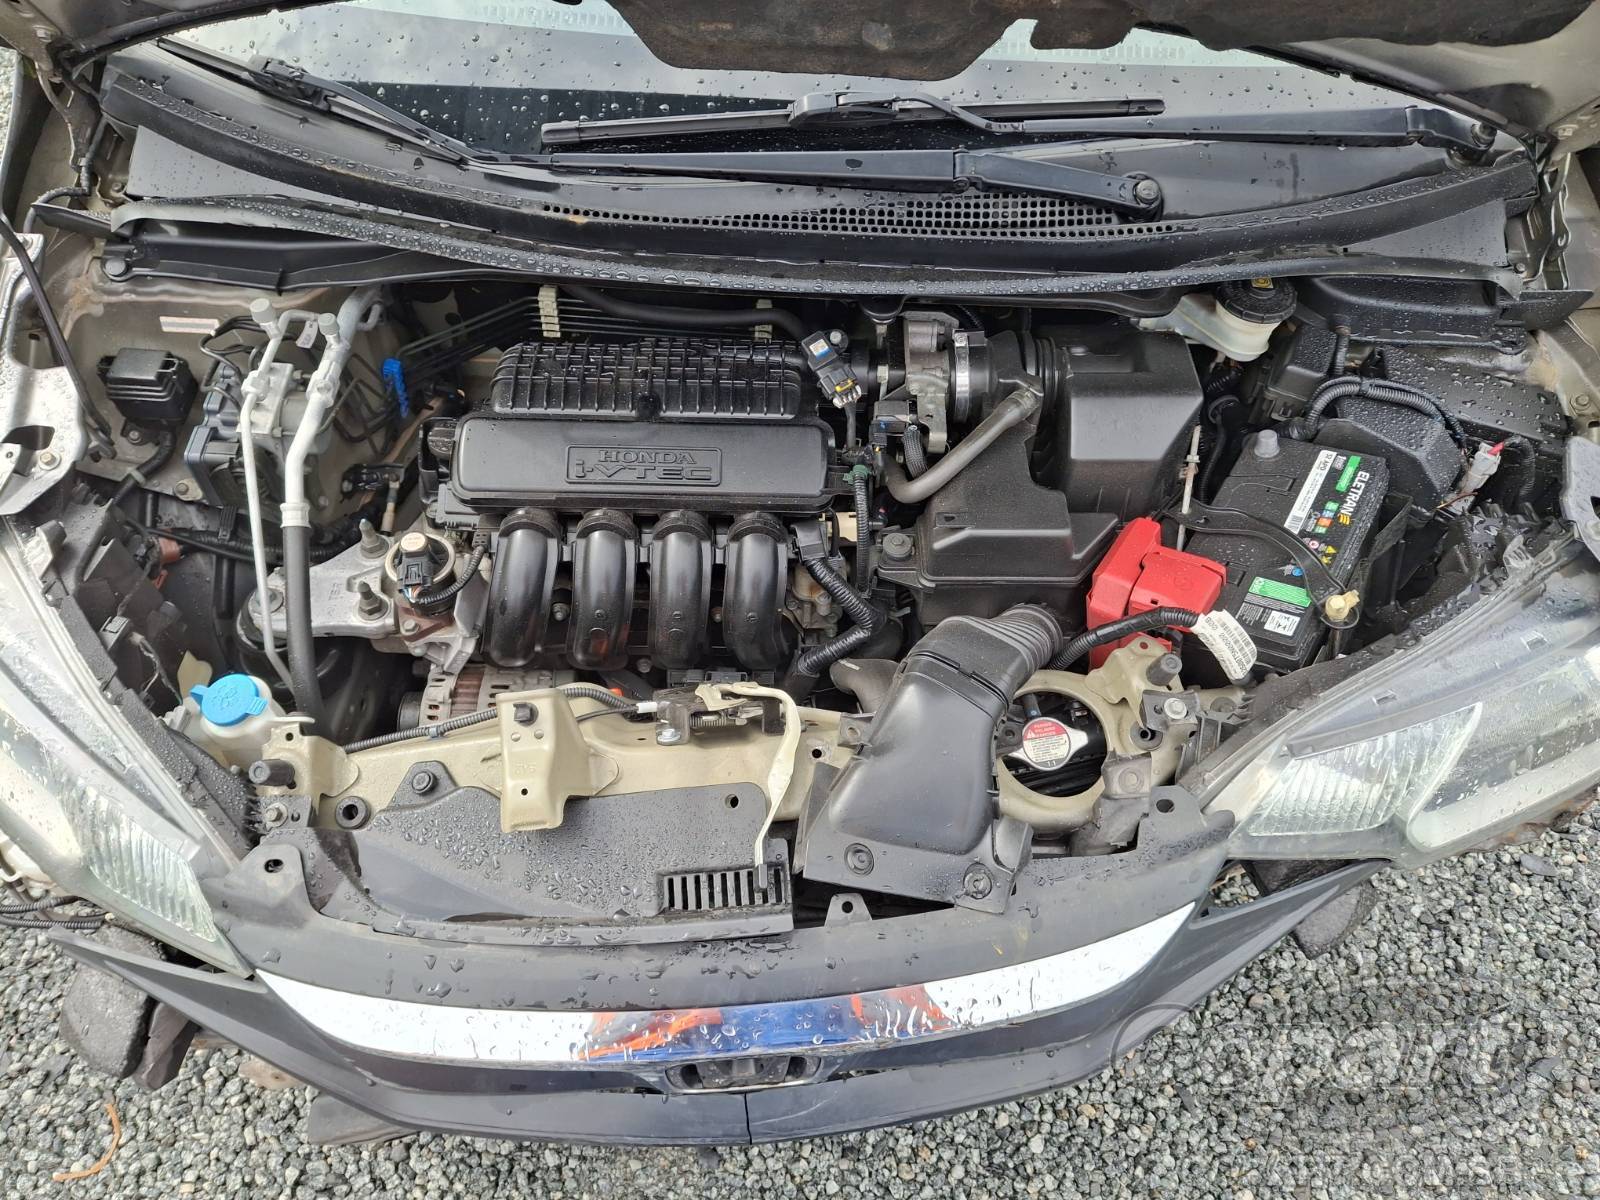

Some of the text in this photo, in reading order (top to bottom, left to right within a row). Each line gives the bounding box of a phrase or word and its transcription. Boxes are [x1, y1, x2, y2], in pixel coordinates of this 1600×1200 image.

[599, 450, 697, 464] HONDA
[575, 459, 712, 481] i-VTEC
[1340, 470, 1370, 516] ELETRAN
